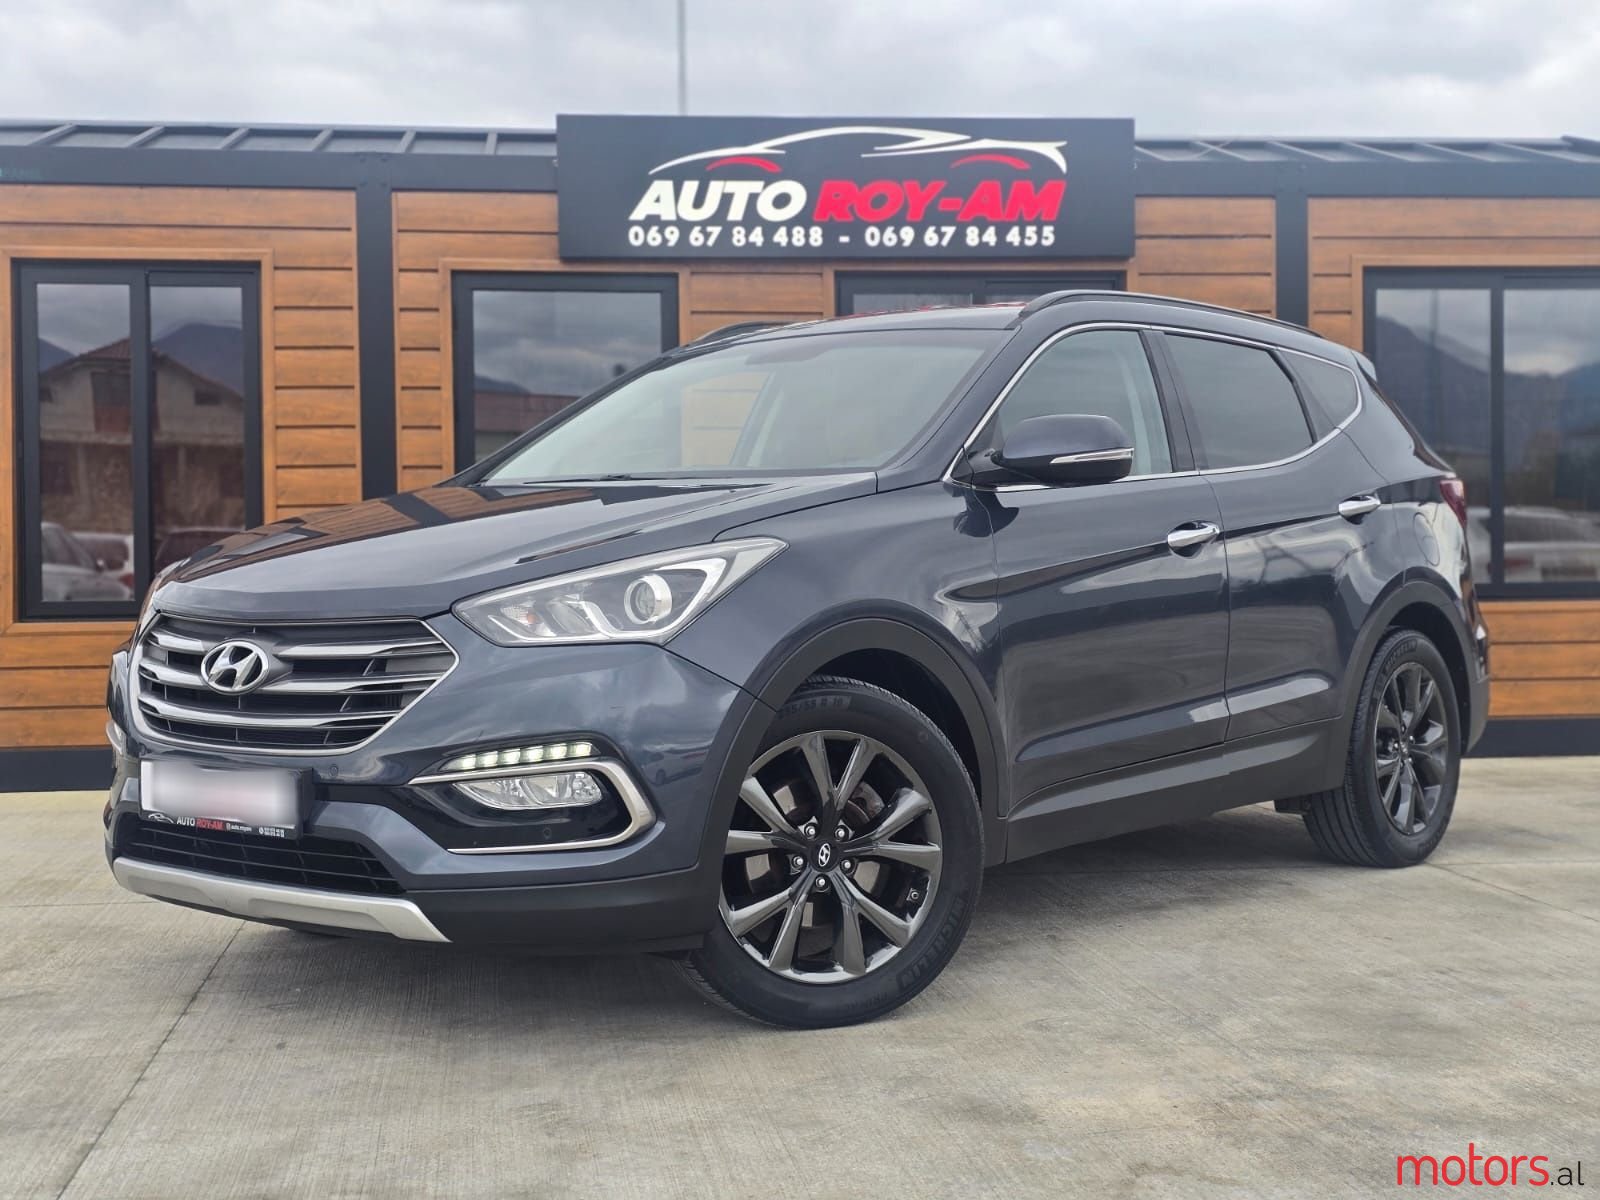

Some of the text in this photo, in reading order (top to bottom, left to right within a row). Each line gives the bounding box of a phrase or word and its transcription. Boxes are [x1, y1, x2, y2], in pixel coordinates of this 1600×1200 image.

[628, 180, 1066, 222] AUTO ROY-AM
[628, 226, 680, 247] 069
[689, 226, 722, 247] 67
[732, 226, 764, 247] 84
[773, 226, 823, 247] 488
[865, 226, 915, 247] 069
[924, 226, 956, 247] 67
[966, 226, 997, 247] 84
[1006, 226, 1056, 247] 455
[176, 816, 196, 827] AUTO
